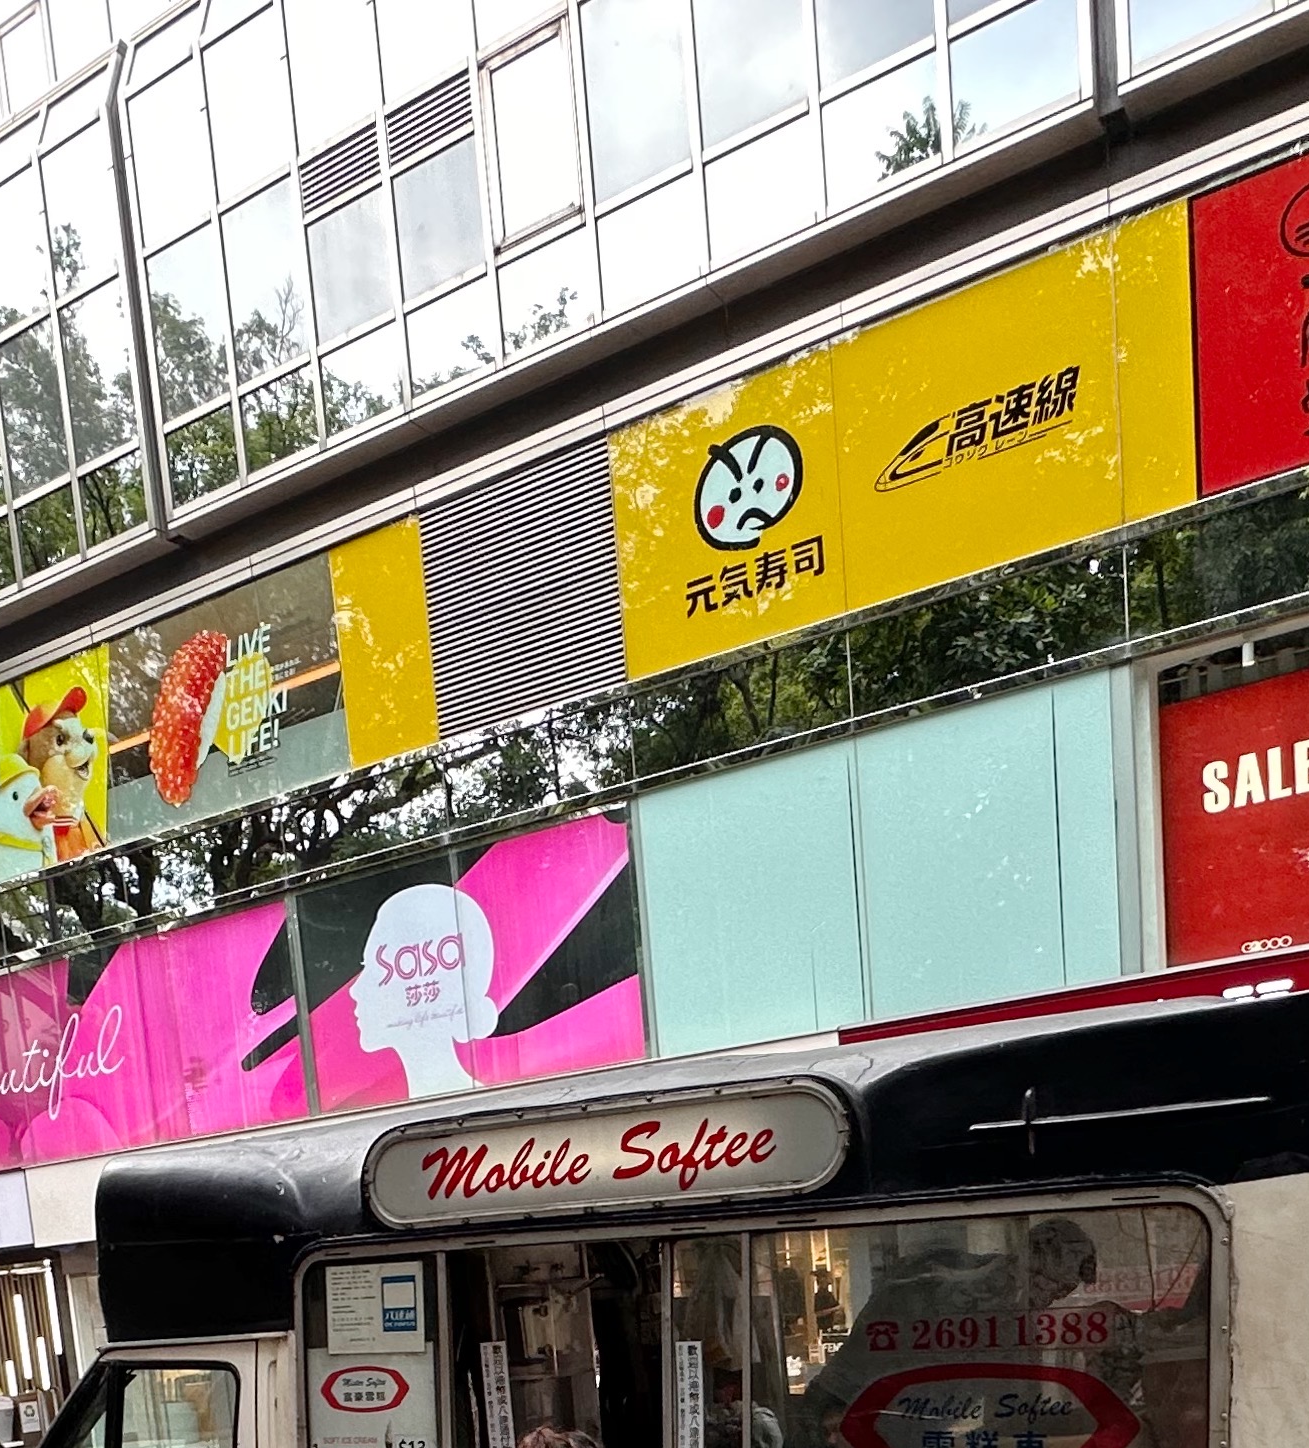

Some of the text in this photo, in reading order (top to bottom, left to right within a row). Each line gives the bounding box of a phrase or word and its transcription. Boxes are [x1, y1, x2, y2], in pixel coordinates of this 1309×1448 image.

[946, 365, 1081, 457] 高速線
[685, 534, 826, 620] 元気寿司
[226, 622, 272, 668] LIVE
[225, 656, 267, 698] THE
[226, 687, 288, 731] GENKI
[227, 718, 280, 764] LIFE!
[421, 1117, 778, 1201] Mobile Softee
[911, 1310, 1111, 1351] 2691 1388
[994, 1392, 1074, 1425] Softee
